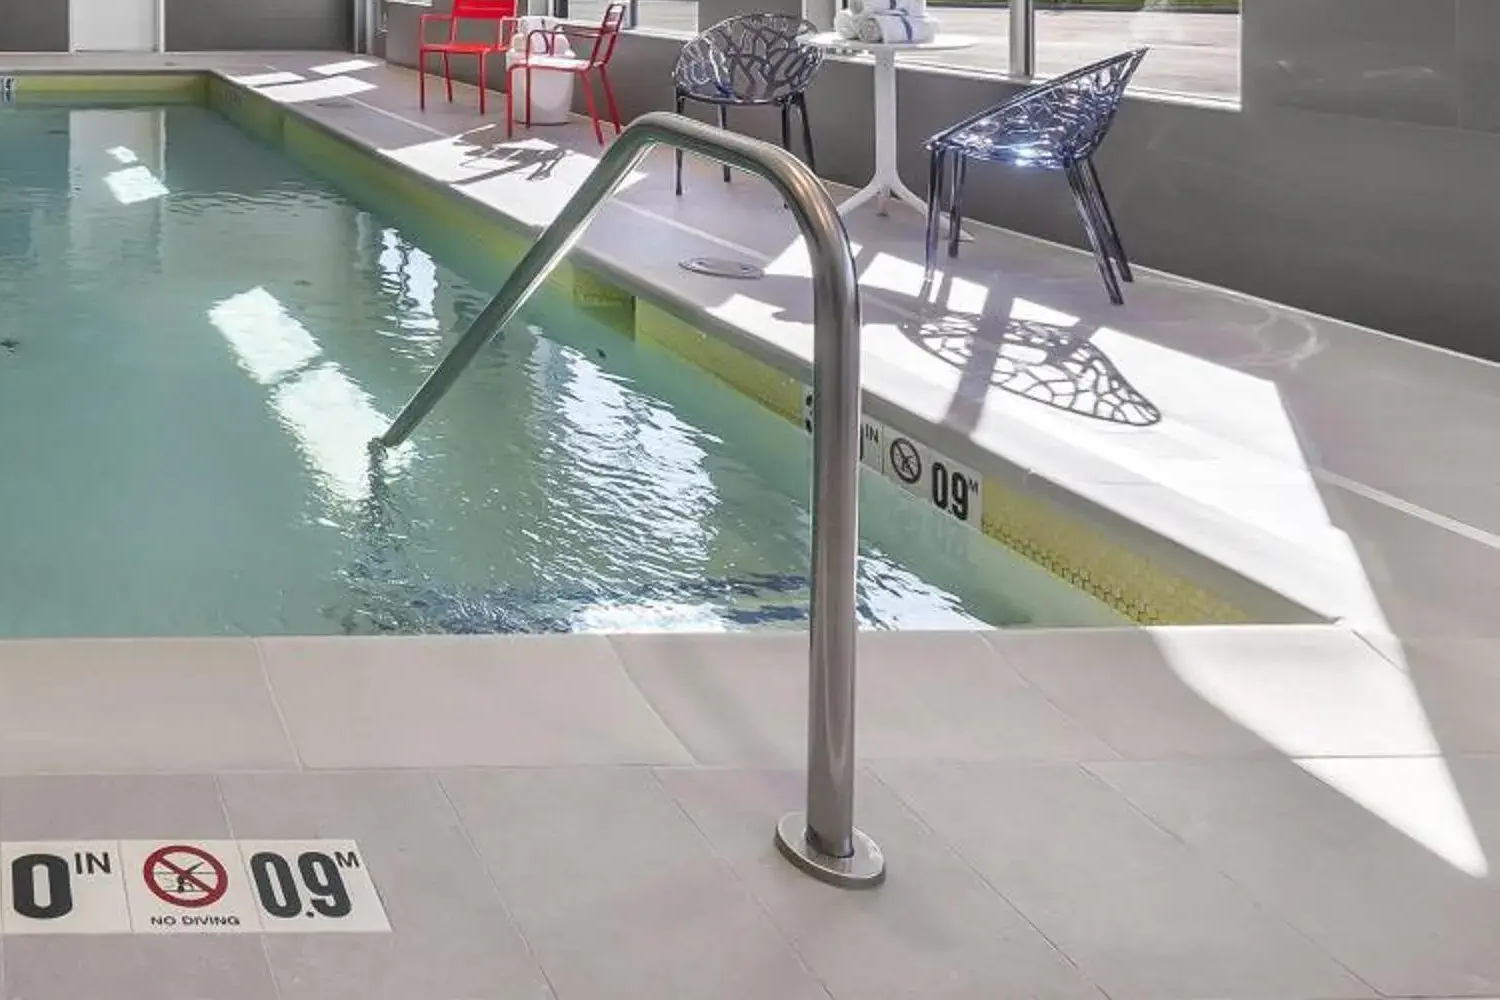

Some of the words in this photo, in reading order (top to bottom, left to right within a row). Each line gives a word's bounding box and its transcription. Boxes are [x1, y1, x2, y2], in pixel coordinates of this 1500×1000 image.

[866, 423, 879, 443] IN
[11, 853, 73, 919] 0
[74, 851, 111, 875] IN
[150, 915, 177, 925] NO
[181, 915, 240, 925] DIVING
